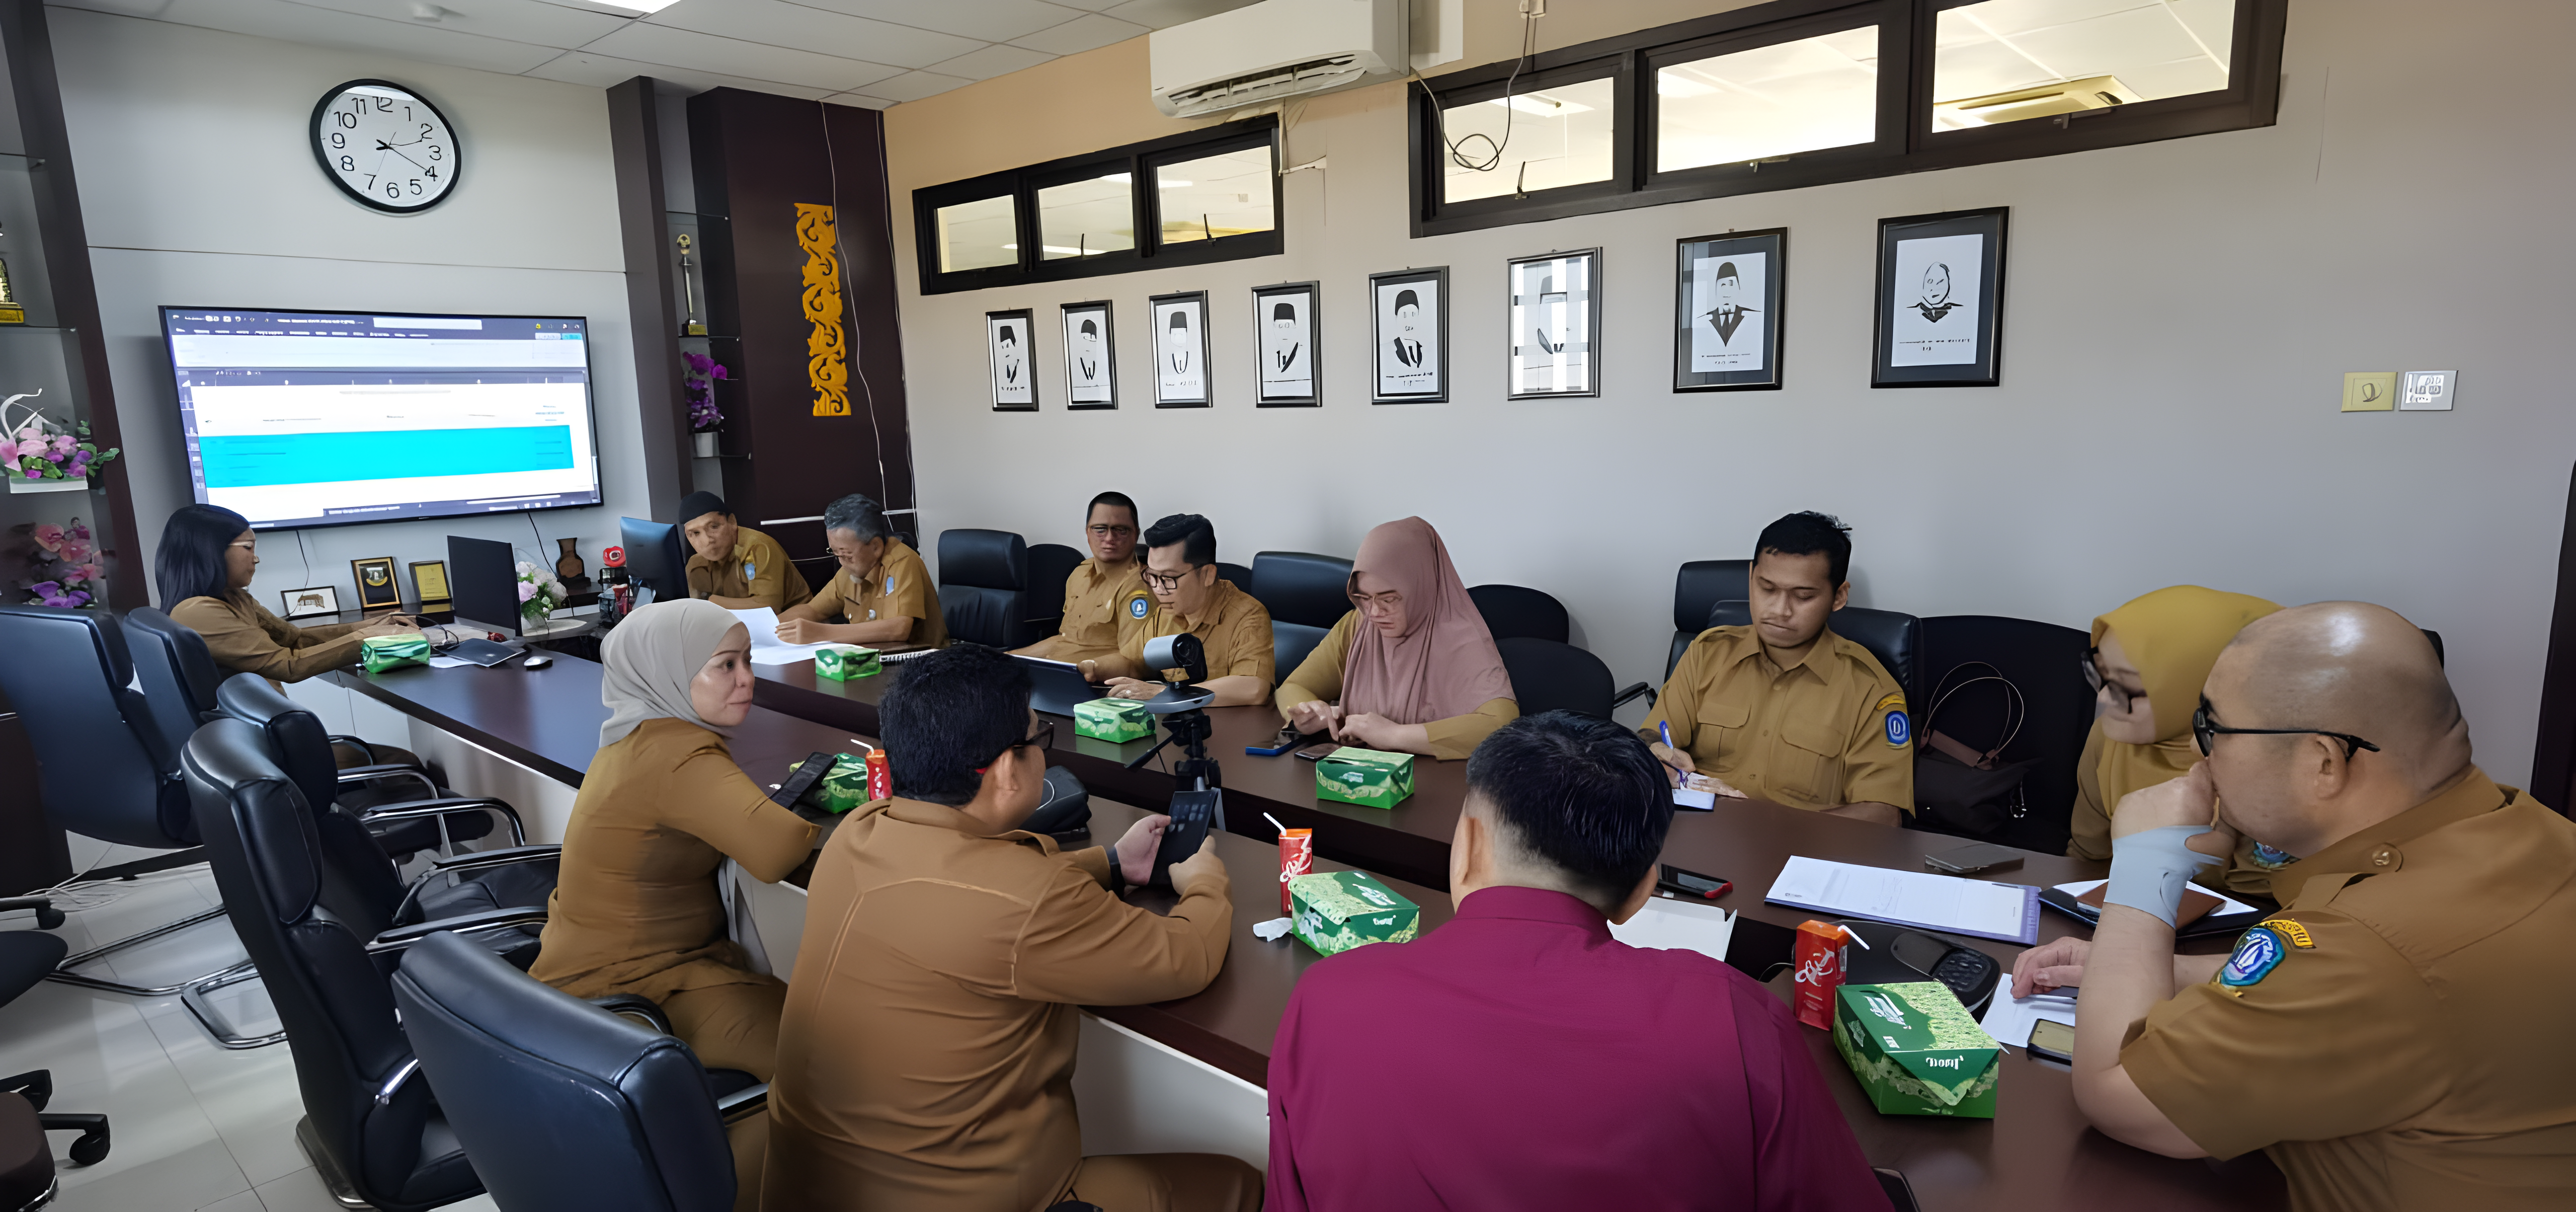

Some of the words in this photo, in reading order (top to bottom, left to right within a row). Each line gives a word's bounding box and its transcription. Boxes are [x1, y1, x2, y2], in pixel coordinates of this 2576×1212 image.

[352, 98, 367, 115] 11
[404, 106, 411, 121] 1
[334, 111, 357, 129] 10
[421, 123, 433, 139] 2
[332, 132, 345, 148] 9
[429, 145, 442, 161] 3
[341, 155, 354, 171] 8
[363, 173, 377, 190] 7
[425, 166, 438, 182] 4
[386, 182, 400, 198] 6
[410, 179, 423, 195] 5
